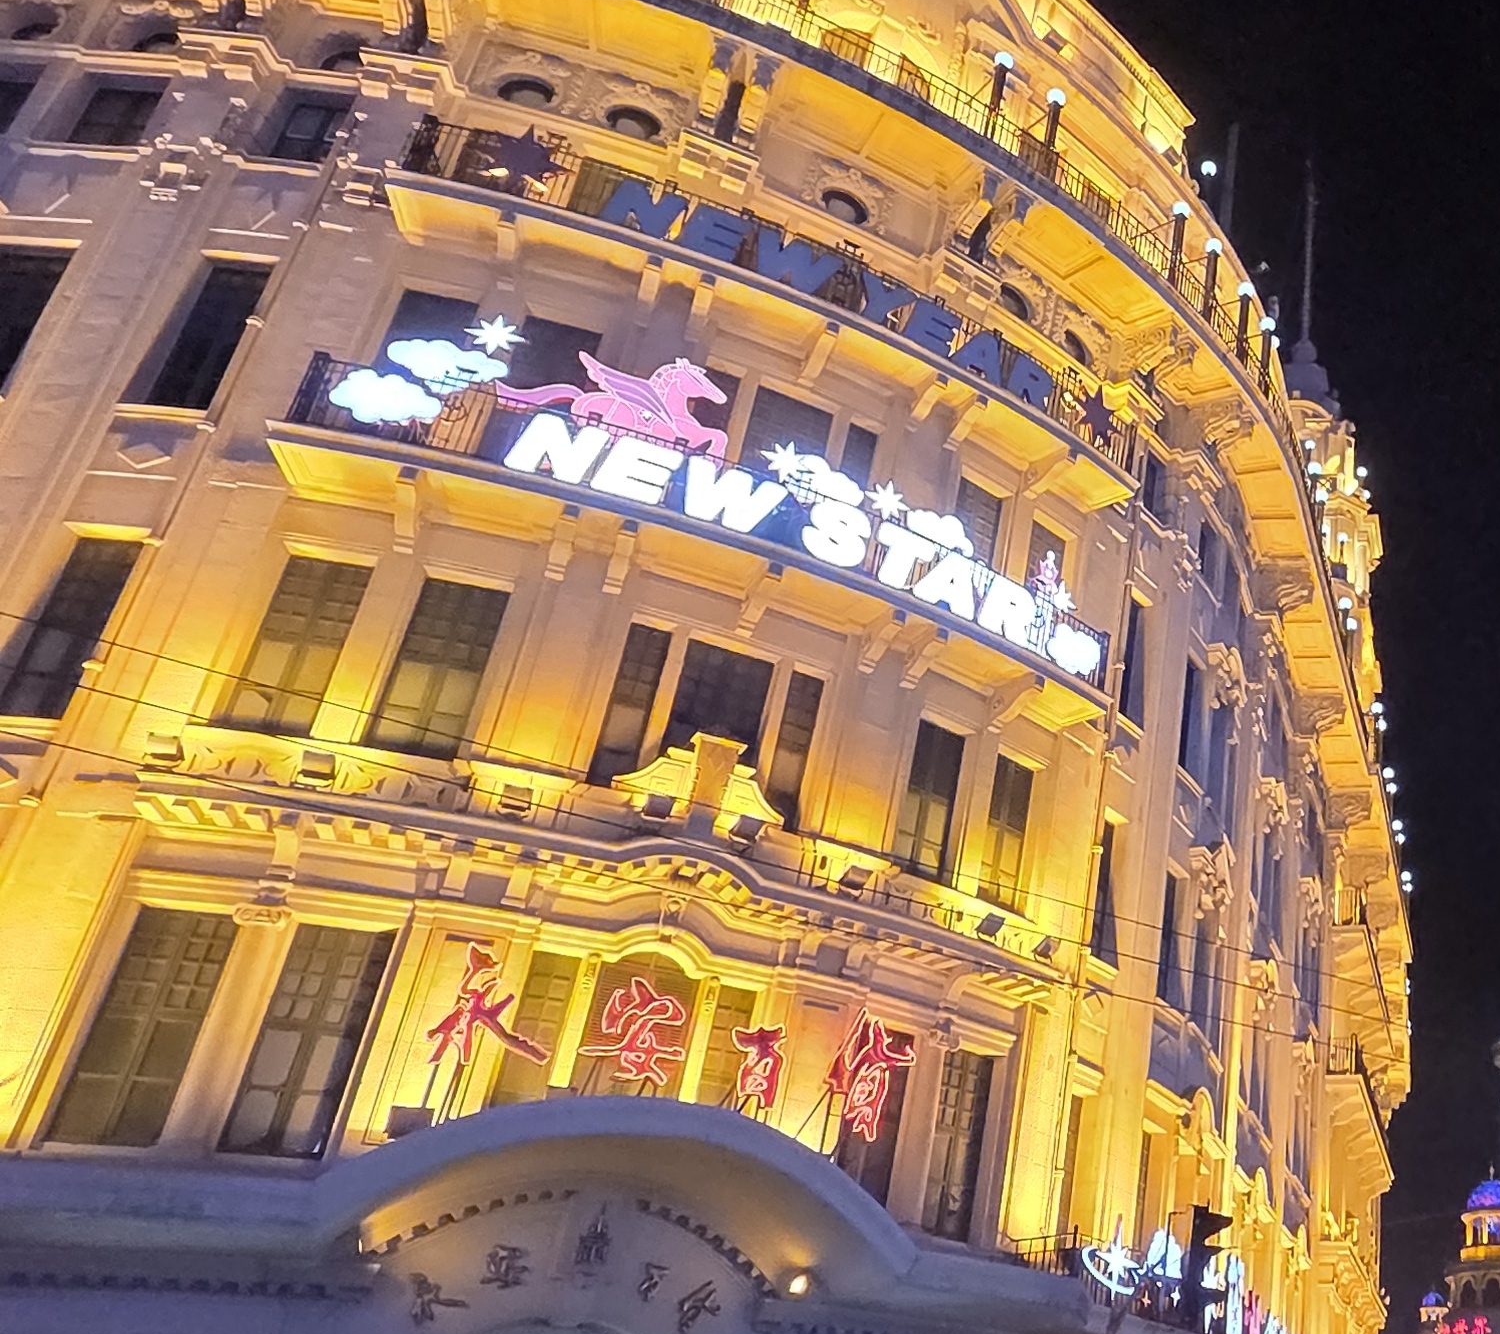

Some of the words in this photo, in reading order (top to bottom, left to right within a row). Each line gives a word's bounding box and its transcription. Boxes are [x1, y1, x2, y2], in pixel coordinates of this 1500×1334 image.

[600, 178, 846, 297] NEW
[860, 272, 1055, 409] YEAR
[503, 411, 789, 535] NEW
[802, 503, 1040, 652] STAR
